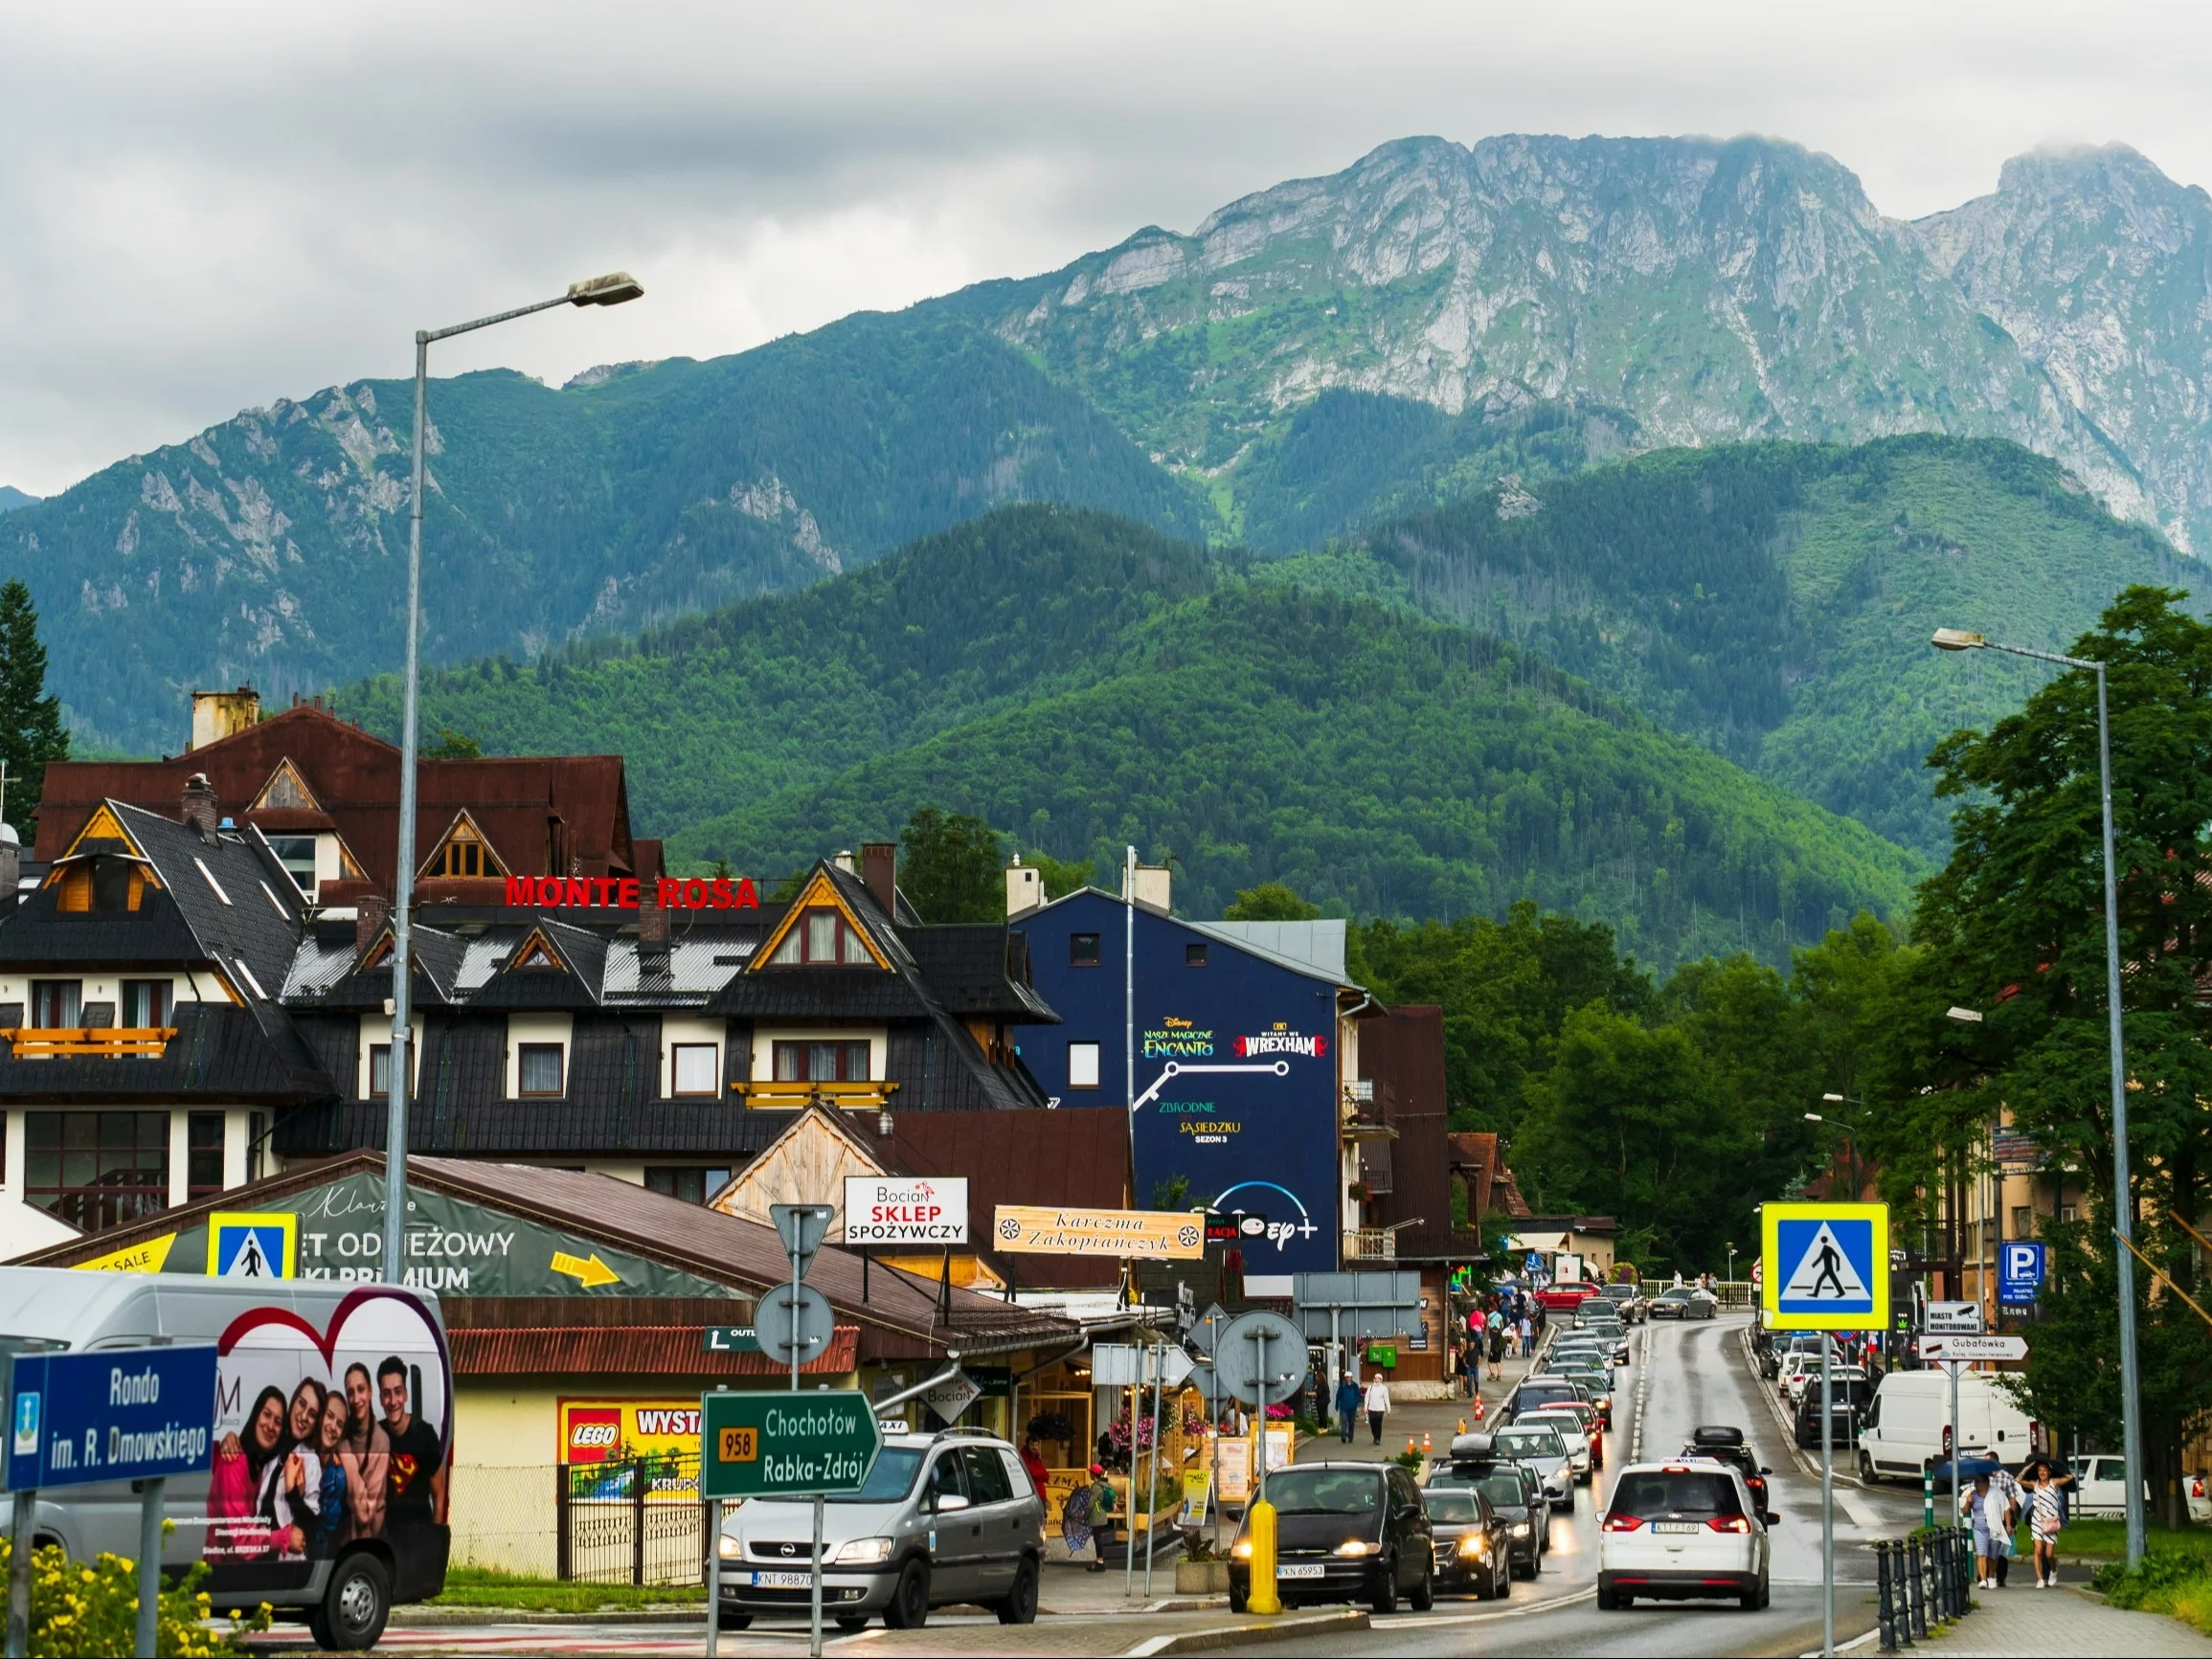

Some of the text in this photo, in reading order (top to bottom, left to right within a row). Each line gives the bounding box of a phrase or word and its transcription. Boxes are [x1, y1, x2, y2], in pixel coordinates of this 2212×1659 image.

[506, 876, 759, 909] MONTE ROSA
[1163, 1017, 1192, 1029] Disney
[1144, 1030, 1213, 1040] NASZE MAGICZNE
[1144, 1040, 1214, 1058] ENCANTO
[1246, 1037, 1316, 1057] WREXHAM
[1159, 1102, 1215, 1112] ZBRODNIE
[1180, 1121, 1241, 1135] SĄSIEDZKU
[871, 1206, 941, 1222] SKLEP
[1055, 1213, 1144, 1230] Karczma
[848, 1222, 963, 1239] SPOŻYWCZY
[1028, 1231, 1169, 1252] Zakopiańczyk
[113, 1250, 151, 1270] SALE
[1952, 1338, 2005, 1348] Gubałówka
[109, 1366, 160, 1405] Rondo
[765, 1408, 857, 1437] Chochołów
[573, 1425, 617, 1446] LEGO
[726, 1433, 752, 1457] 958
[51, 1422, 206, 1469] im. R. Dmowskiego
[764, 1452, 864, 1486] Rabka-Zdrój
[758, 1574, 812, 1585] KNT 98870
